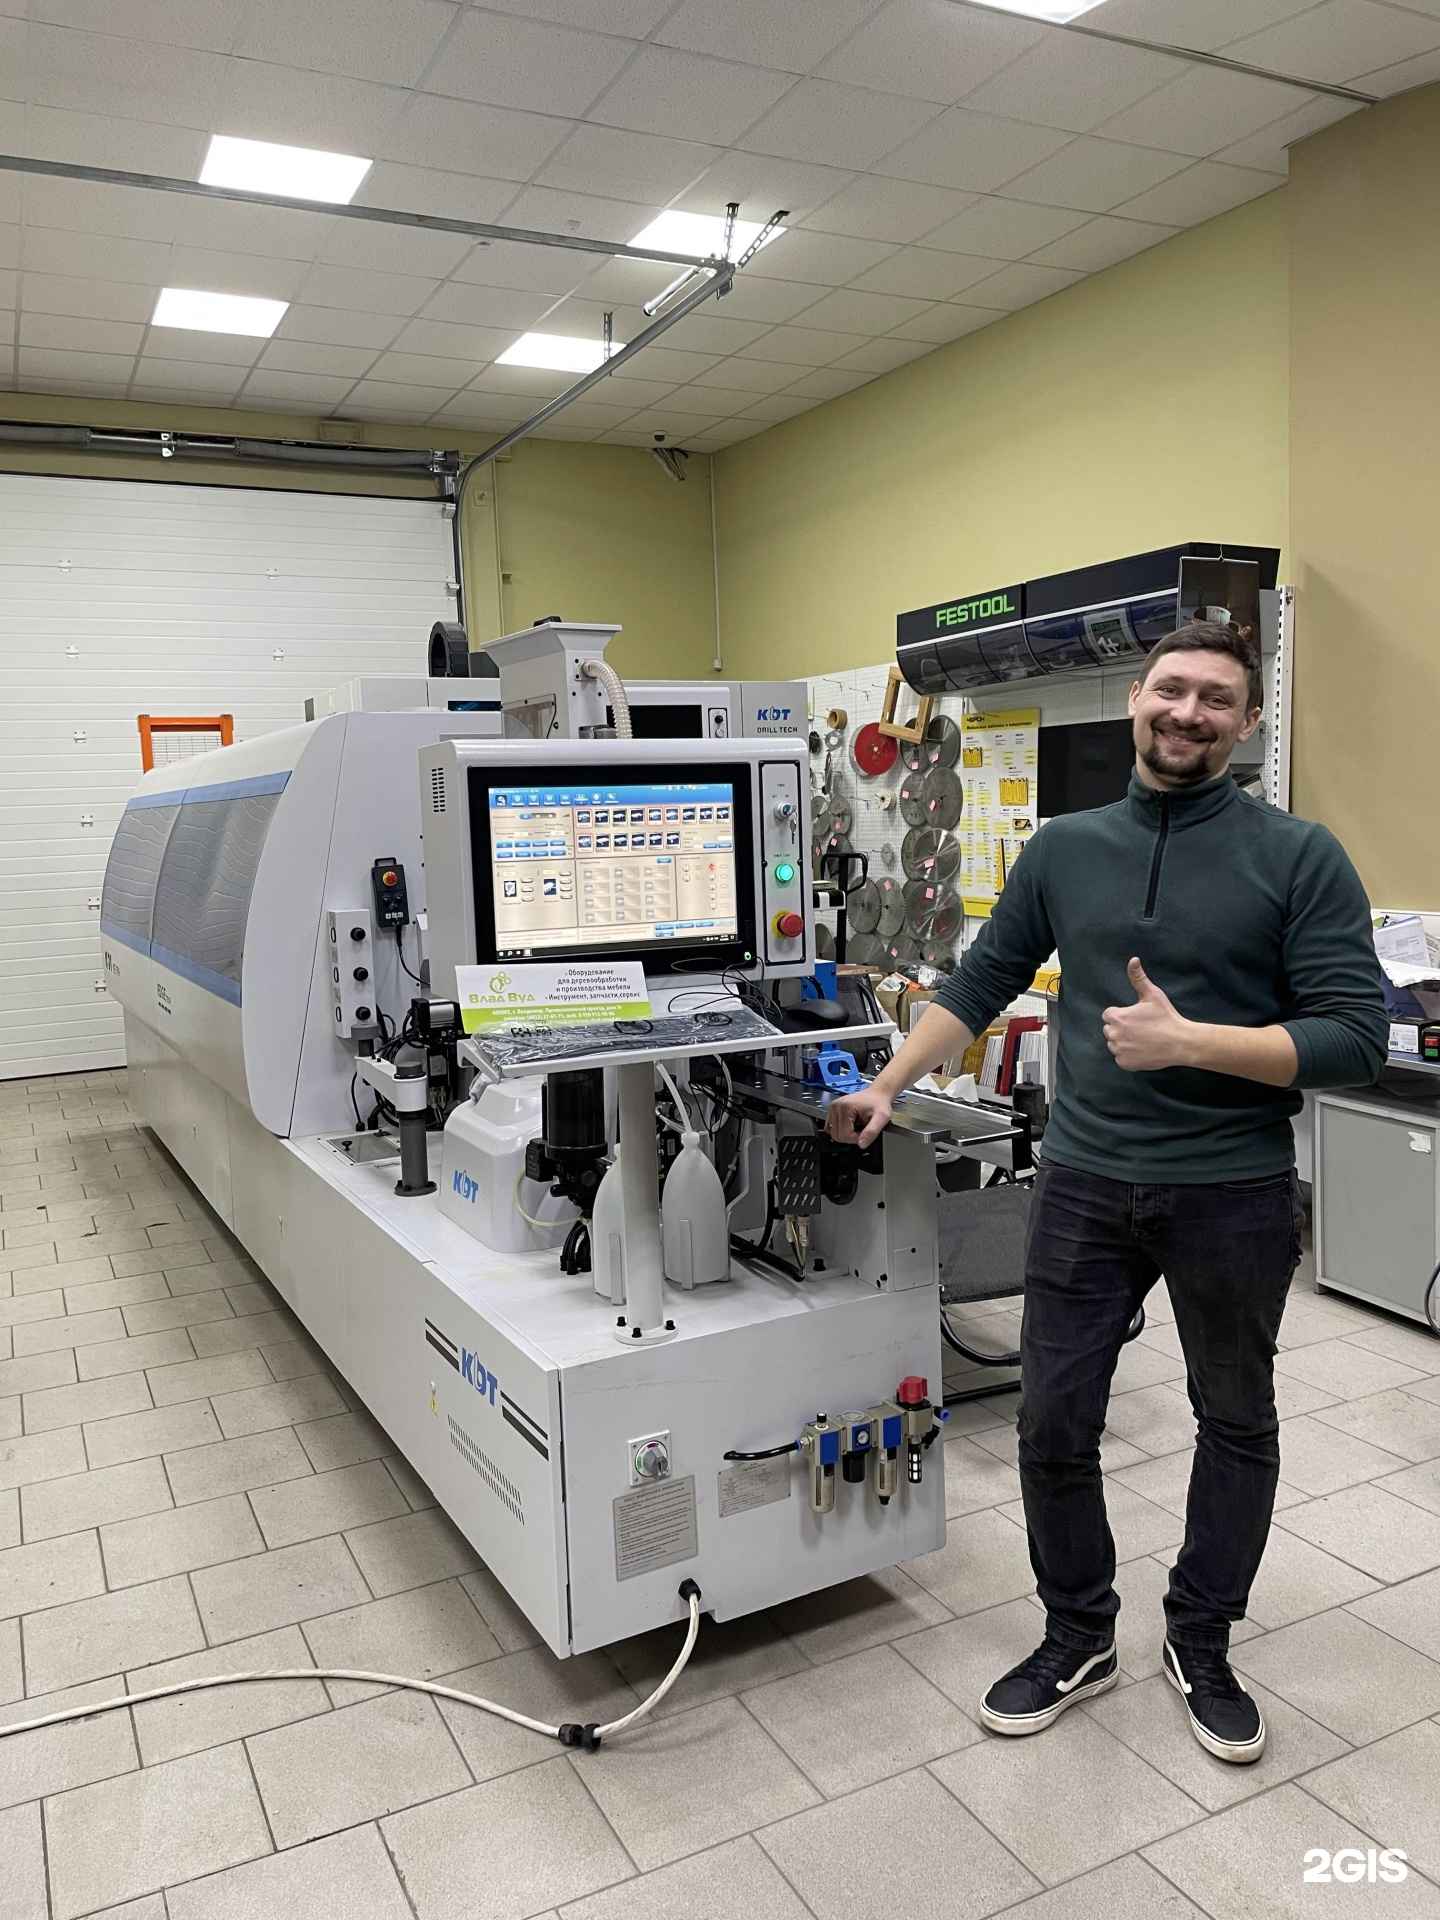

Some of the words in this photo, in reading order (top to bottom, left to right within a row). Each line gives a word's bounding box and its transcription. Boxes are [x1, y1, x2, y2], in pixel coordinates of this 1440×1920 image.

[936, 594, 1015, 628] FESTOOL
[757, 706, 791, 721] KDT
[757, 726, 777, 734] DRILL
[779, 726, 798, 734] TECH
[568, 968, 614, 977] Оборудование
[557, 977, 570, 985] для
[571, 976, 627, 985] деревообработки
[561, 985, 606, 993] производства
[606, 983, 631, 991] мебели
[453, 1169, 479, 1203] KDT
[461, 1347, 498, 1407] KDT
